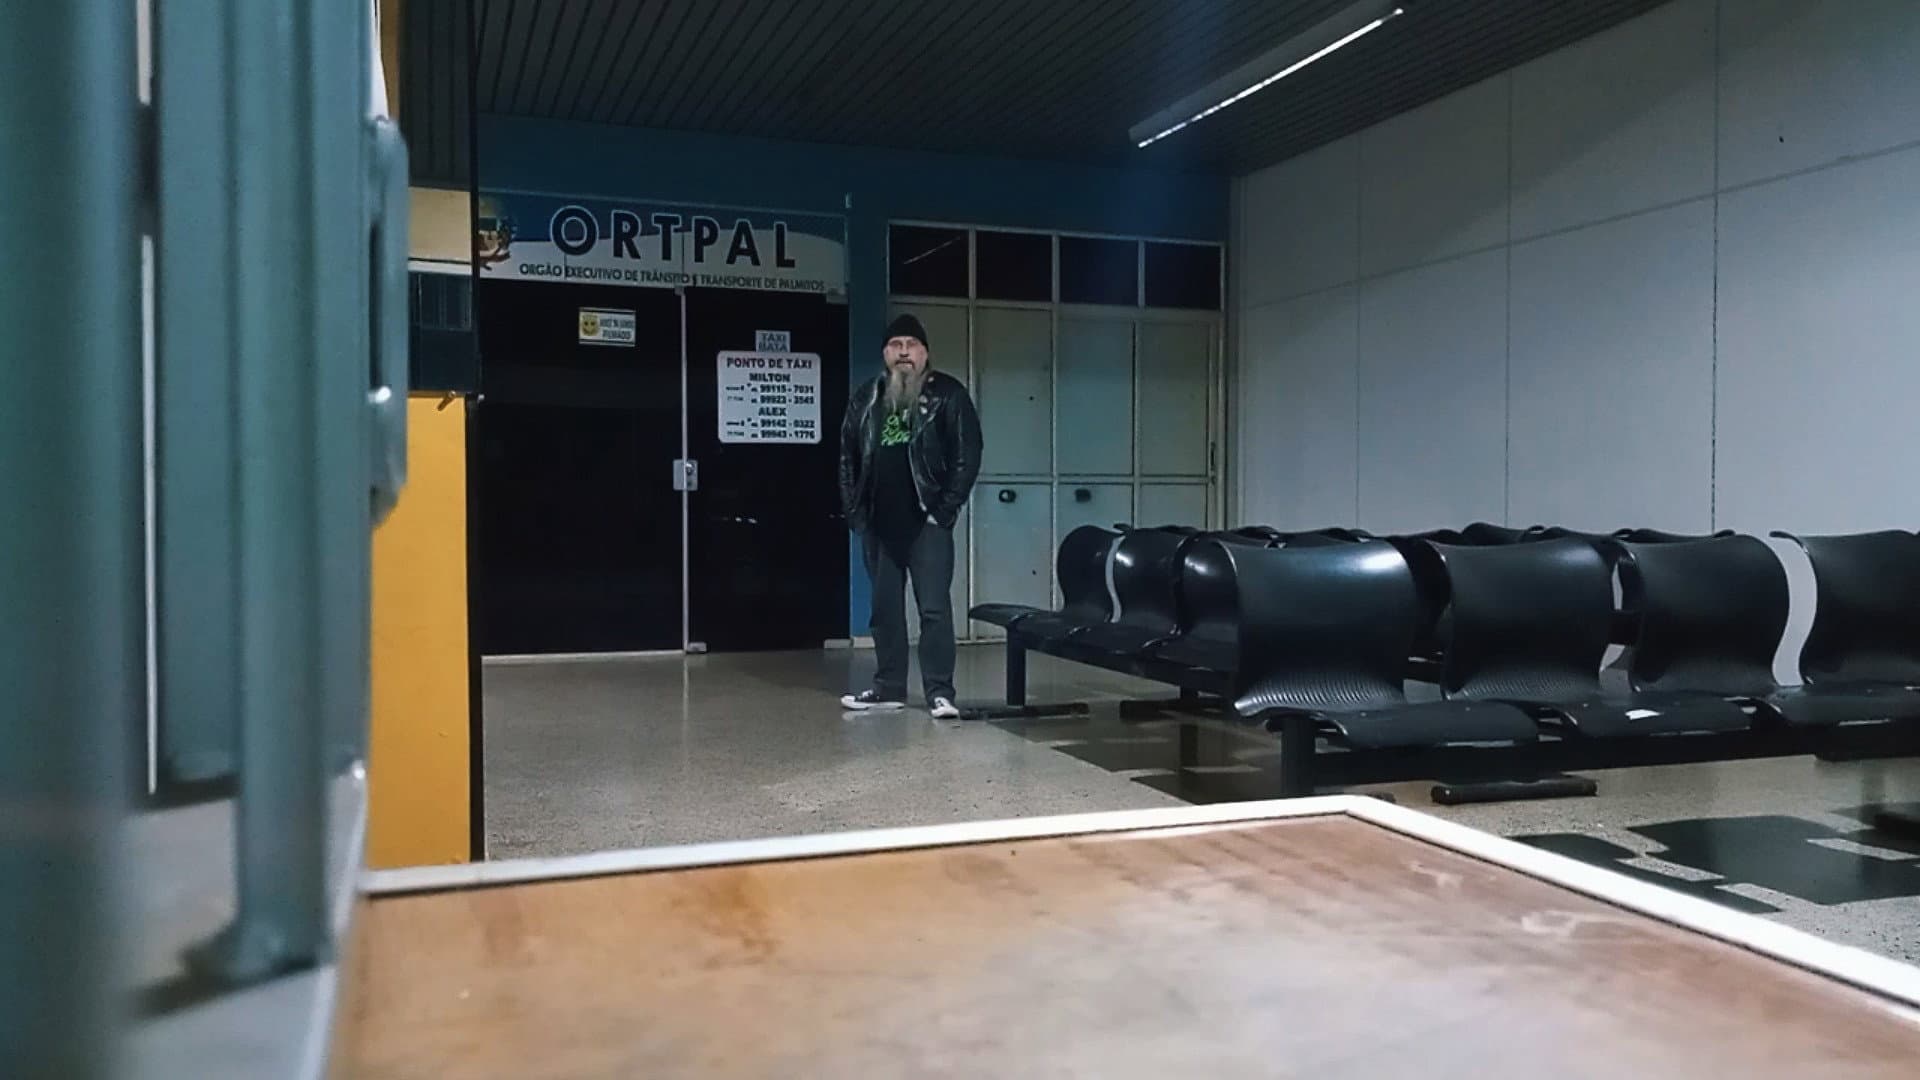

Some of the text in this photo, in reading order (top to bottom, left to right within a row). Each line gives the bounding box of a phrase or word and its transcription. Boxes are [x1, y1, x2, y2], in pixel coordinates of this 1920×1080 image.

[550, 205, 796, 268] ORTPAL
[564, 265, 622, 281] EXECUTIVO
[625, 270, 638, 282] DE
[700, 273, 762, 289] TRANSPORTE
[764, 277, 776, 288] DE
[779, 278, 825, 291] PALMITOS
[726, 357, 765, 369] PONTO
[768, 358, 783, 369] DE
[749, 373, 790, 383] MILTON
[758, 407, 787, 417] ALEX
